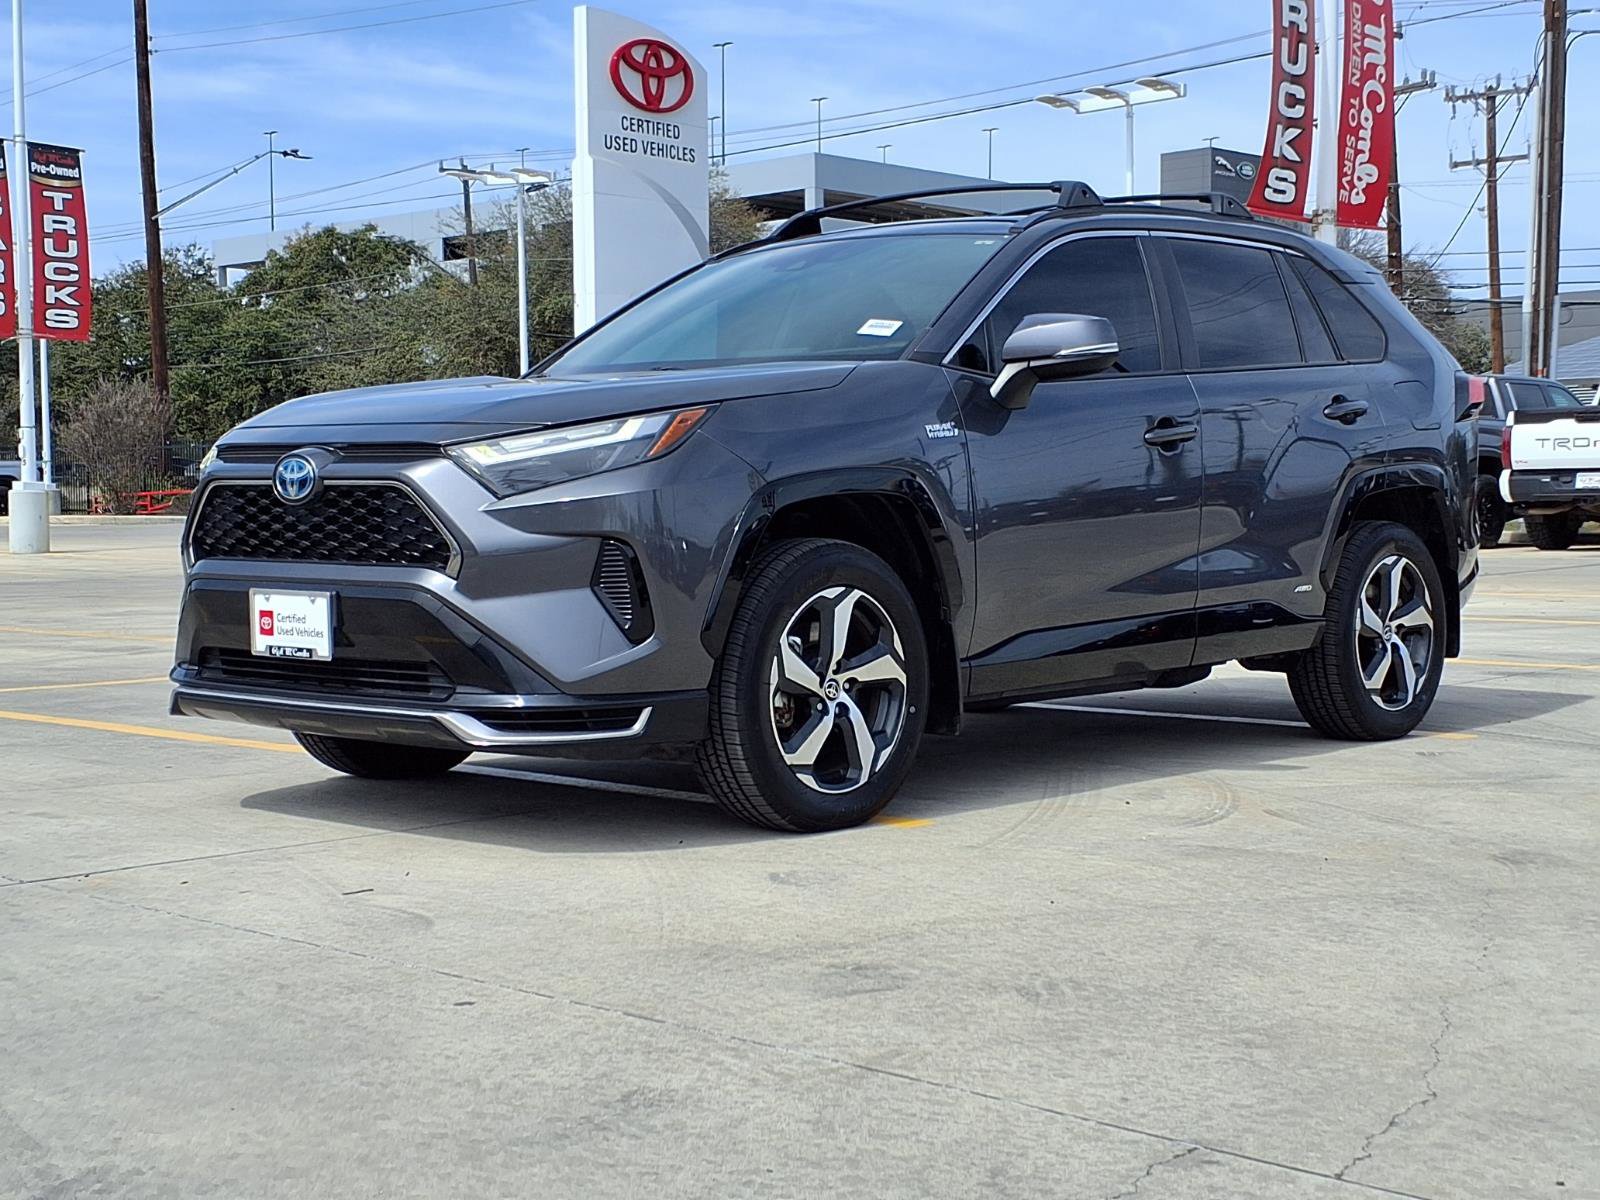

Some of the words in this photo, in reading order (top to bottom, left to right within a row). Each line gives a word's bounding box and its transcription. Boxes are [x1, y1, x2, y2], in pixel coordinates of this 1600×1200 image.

[1350, 4, 1362, 87] DRIVEN
[1348, 97, 1359, 127] TO
[621, 115, 680, 140] CERTIFIED
[604, 134, 638, 154] USED
[641, 141, 696, 163] VEHICLES
[31, 162, 80, 178] Pre-Owned
[1339, 134, 1356, 204] SERVE
[42, 190, 81, 329] TRUCKS
[277, 613, 306, 624] Certified
[277, 627, 294, 636] Used
[295, 628, 324, 638] Vehicles
